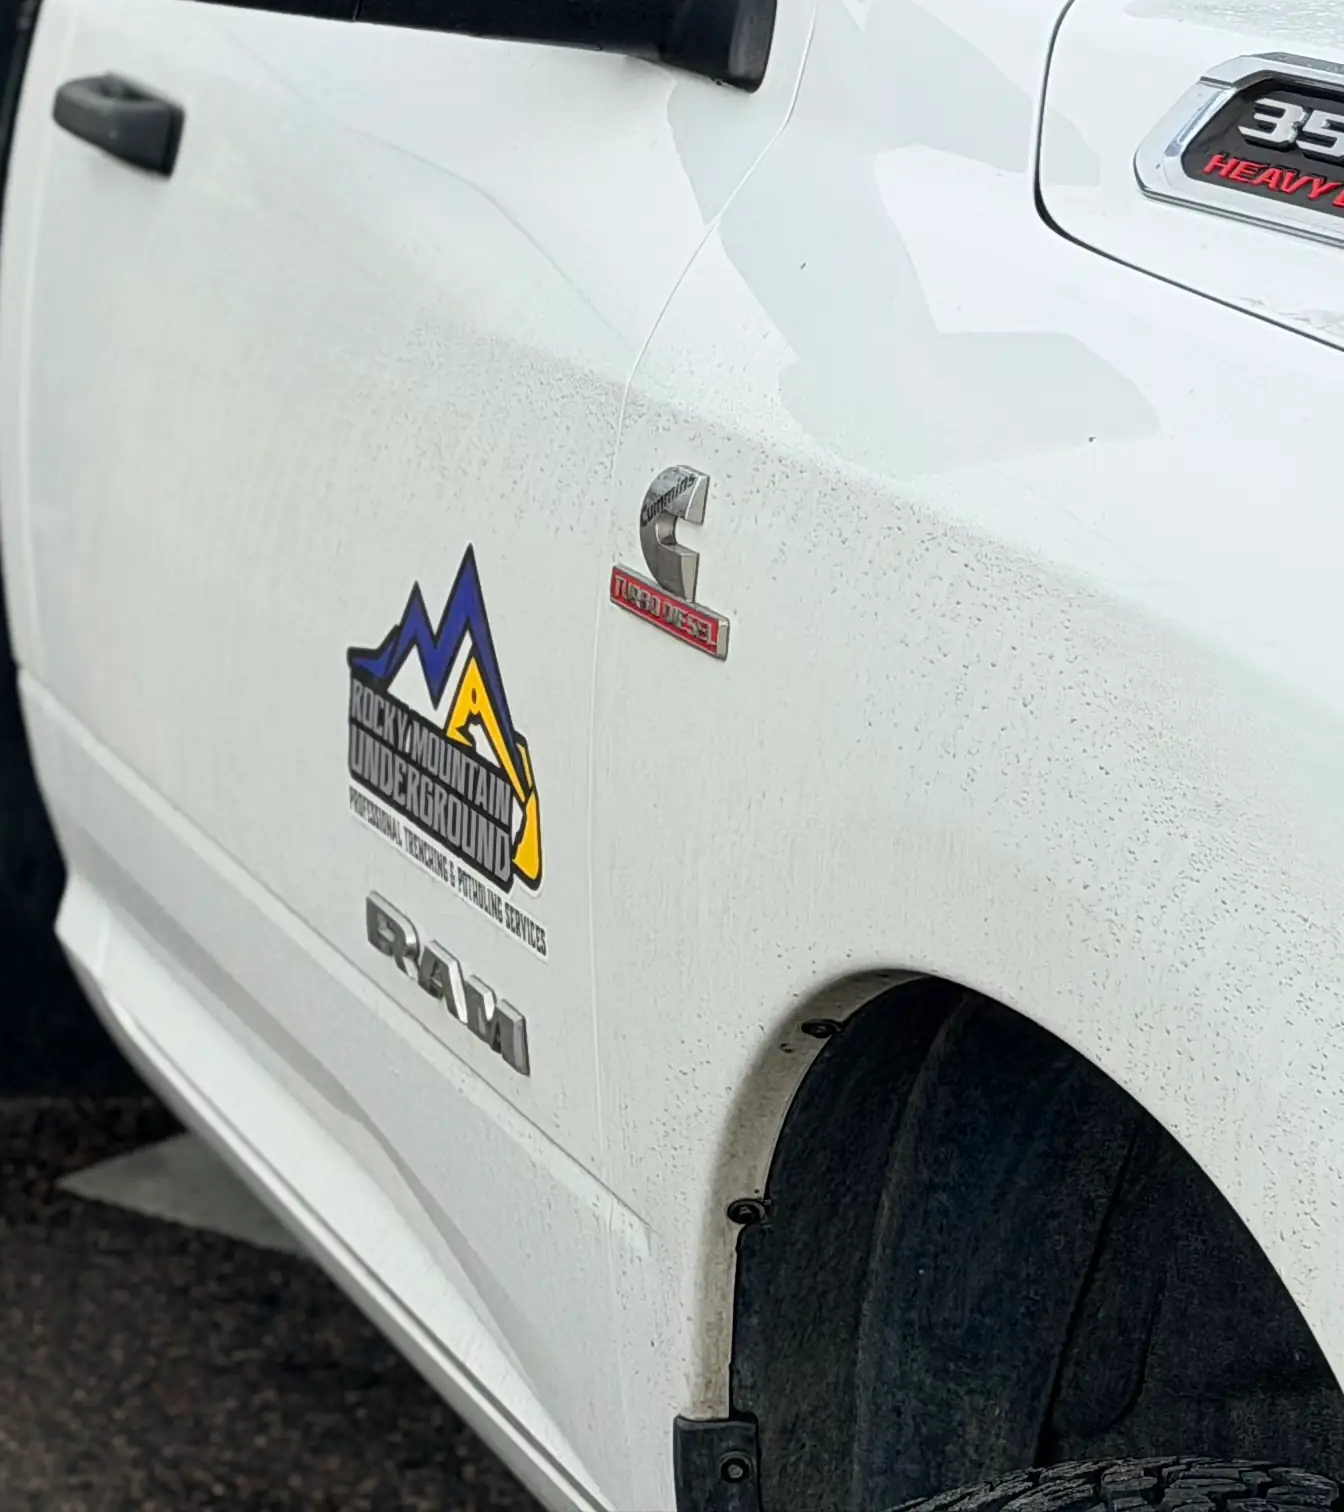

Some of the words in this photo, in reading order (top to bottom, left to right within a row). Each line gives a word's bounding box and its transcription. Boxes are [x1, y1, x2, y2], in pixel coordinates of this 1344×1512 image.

[1203, 154, 1343, 200] HEAVY
[640, 473, 697, 527] Cummins
[614, 576, 661, 618] TURBO
[663, 601, 718, 646] DIESEL
[351, 678, 410, 753] ROCKY
[411, 720, 512, 824] MOUNTAIN
[351, 725, 512, 883] UNDERGROUND
[349, 786, 404, 848] PROFESSIONAL
[403, 826, 449, 884] TRENCHING
[449, 864, 457, 889] &
[458, 869, 504, 925] POTHOLING
[504, 900, 548, 958] SERVICES
[365, 889, 531, 1078] RAM
